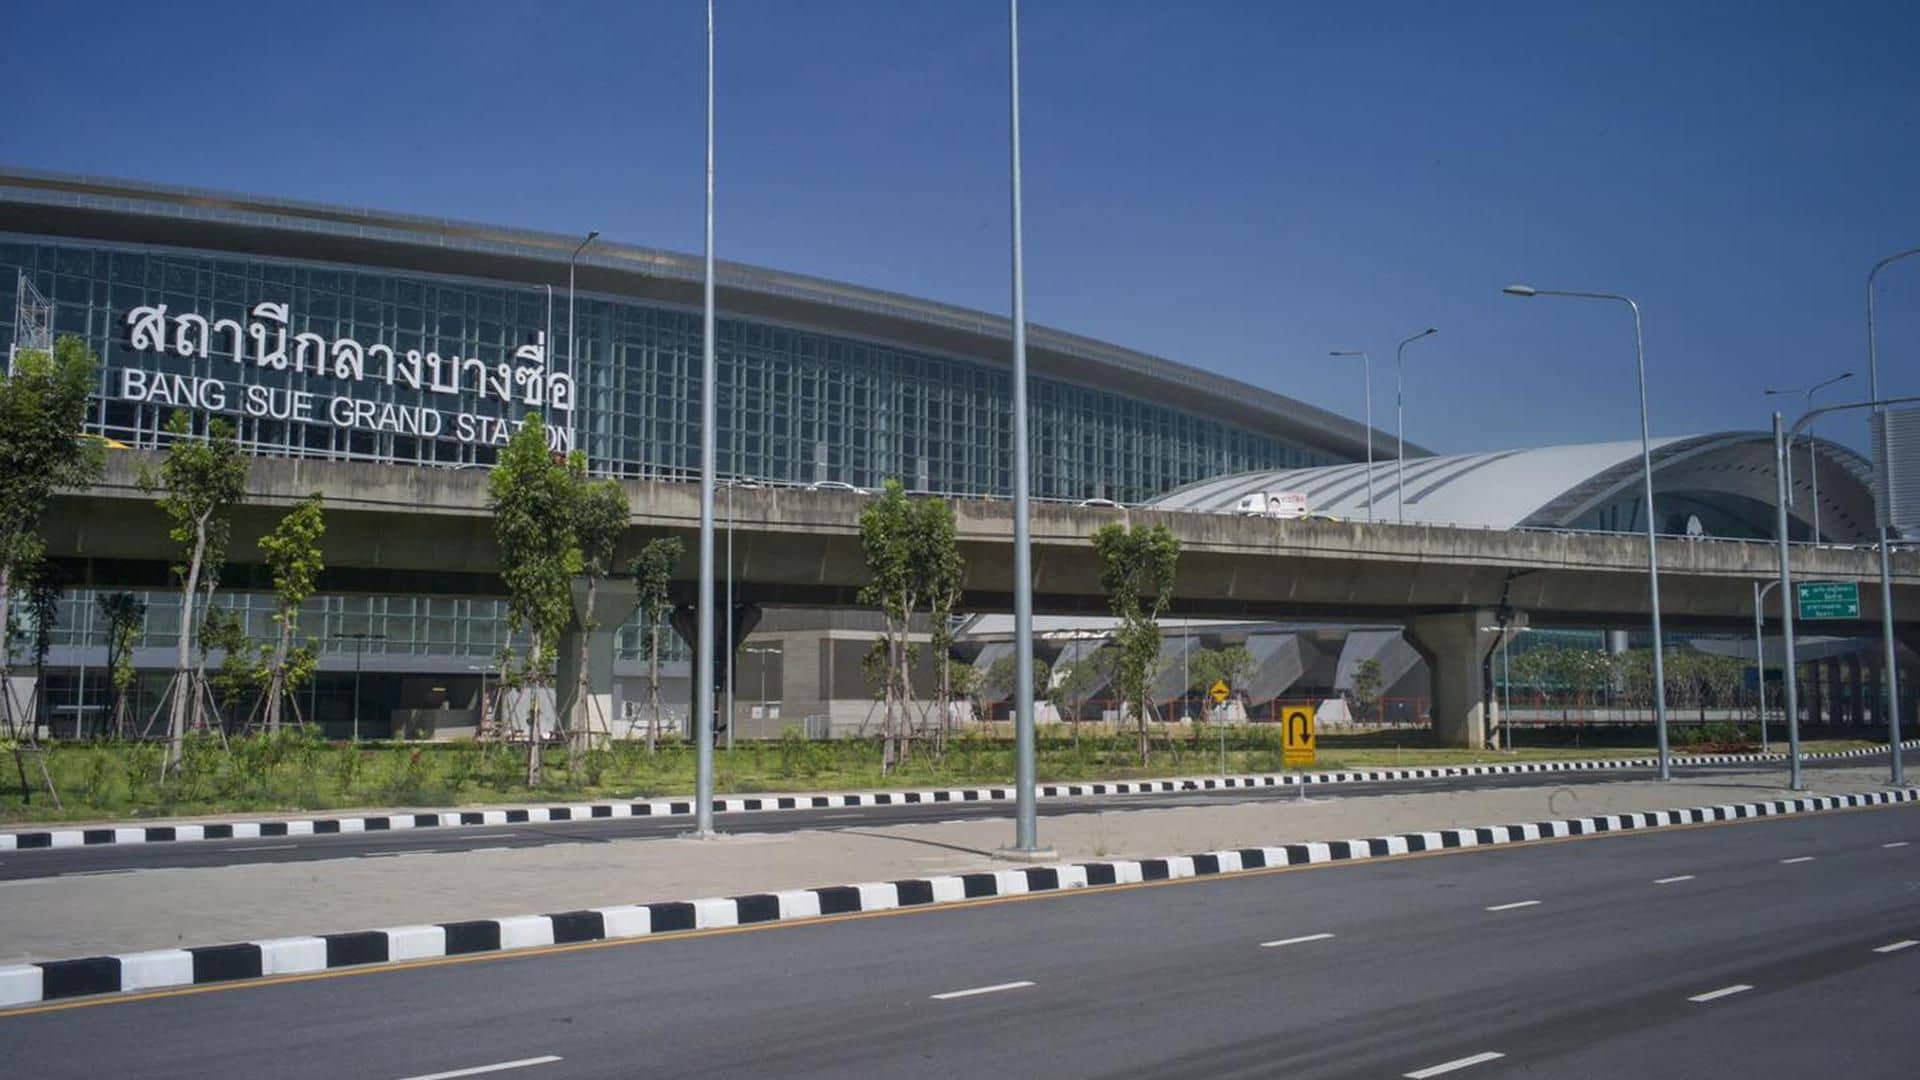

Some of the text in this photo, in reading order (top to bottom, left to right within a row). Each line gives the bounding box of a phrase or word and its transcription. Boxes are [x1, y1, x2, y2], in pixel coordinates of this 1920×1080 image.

[127, 302, 576, 412] สถานีกลางบางซื่อ
[122, 368, 576, 453] BANG SUE GRAND STATON
